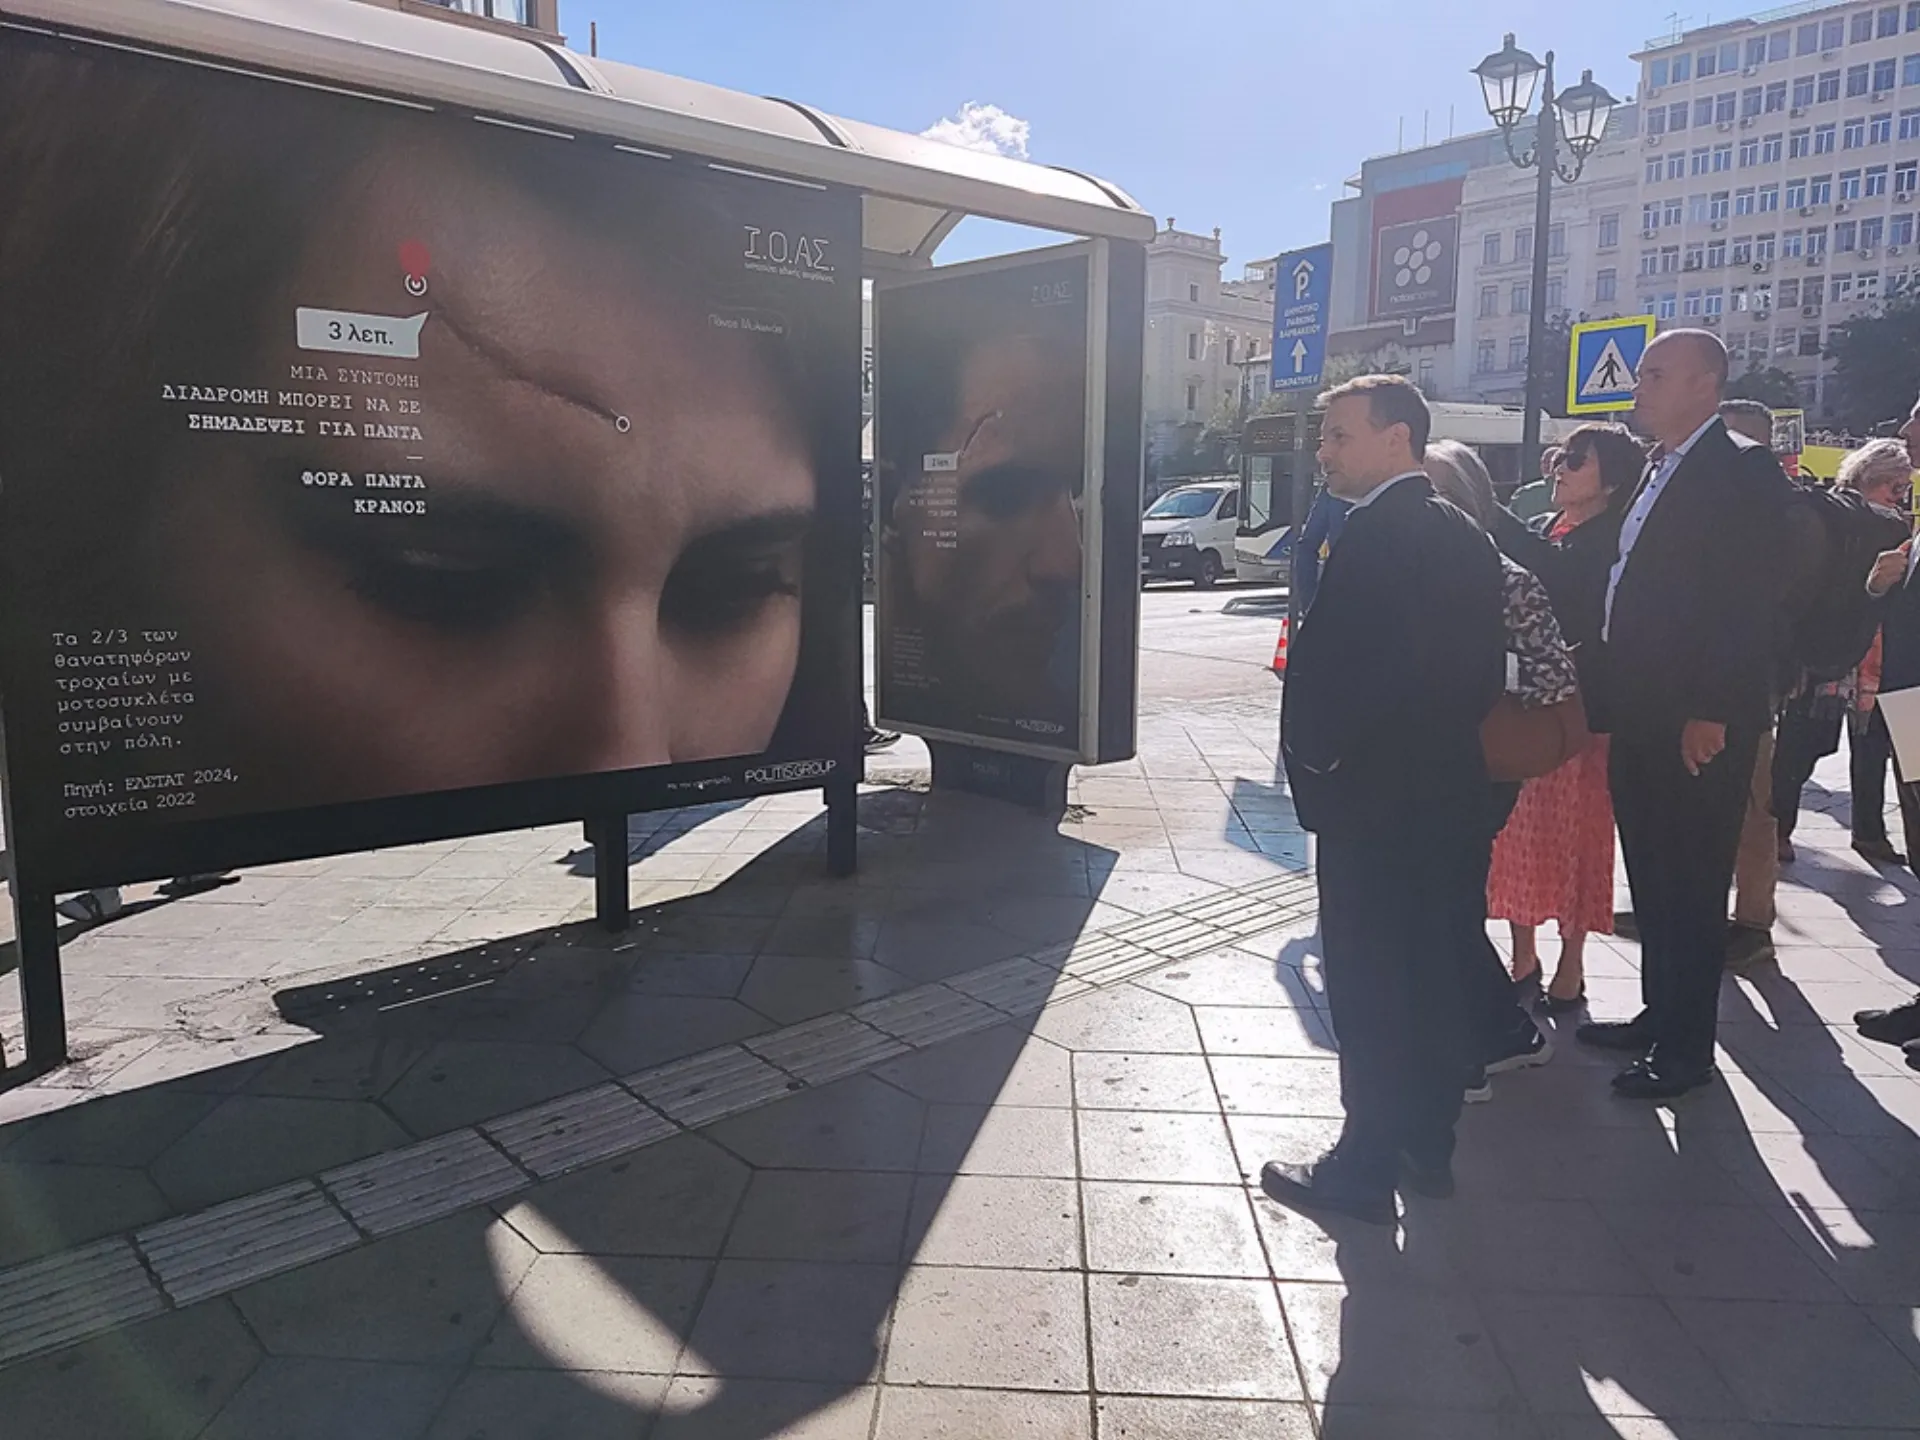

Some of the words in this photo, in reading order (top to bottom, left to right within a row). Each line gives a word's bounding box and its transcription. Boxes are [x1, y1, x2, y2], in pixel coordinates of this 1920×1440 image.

[329, 321, 341, 341] 3
[347, 324, 394, 346] λεπ.
[290, 365, 328, 382] ΜΙΑ
[337, 367, 419, 388] ΣΥΝΤΟΜΗ
[161, 385, 269, 405] ΔΙΑΔΡΟΜΗ
[278, 392, 353, 410] ΜΠΟΡΕΙ
[365, 395, 390, 412] ΝΑ
[398, 400, 421, 414] ΣΕ
[187, 413, 305, 434] ΣΗΜΑΔΕΨΕΙ
[318, 421, 356, 437] ΓΙΑ
[364, 422, 423, 441] ΠΑΝΤΑ
[300, 471, 354, 487] ΦΟΡΑ
[365, 473, 426, 490] ΠΑΝΤΑ
[354, 499, 427, 514] ΚΡΑΝΟΣ
[52, 632, 78, 647] Τα
[91, 629, 128, 645] 2/3
[141, 630, 178, 643] των
[54, 650, 191, 669] θανατηφόρων
[55, 672, 156, 692] τροχαίων
[168, 671, 193, 686] με
[57, 691, 195, 713] μοτοσυκλέτα
[58, 713, 183, 733] συμβαίνουν
[60, 739, 111, 755] στην
[125, 734, 182, 749] πόλη.
[63, 779, 114, 800] Πηγή:
[125, 773, 185, 791] ΕΛΣΤΑΤ
[194, 768, 240, 785] 2024,
[64, 797, 148, 819] στοιχεία
[156, 792, 196, 808] 2022
